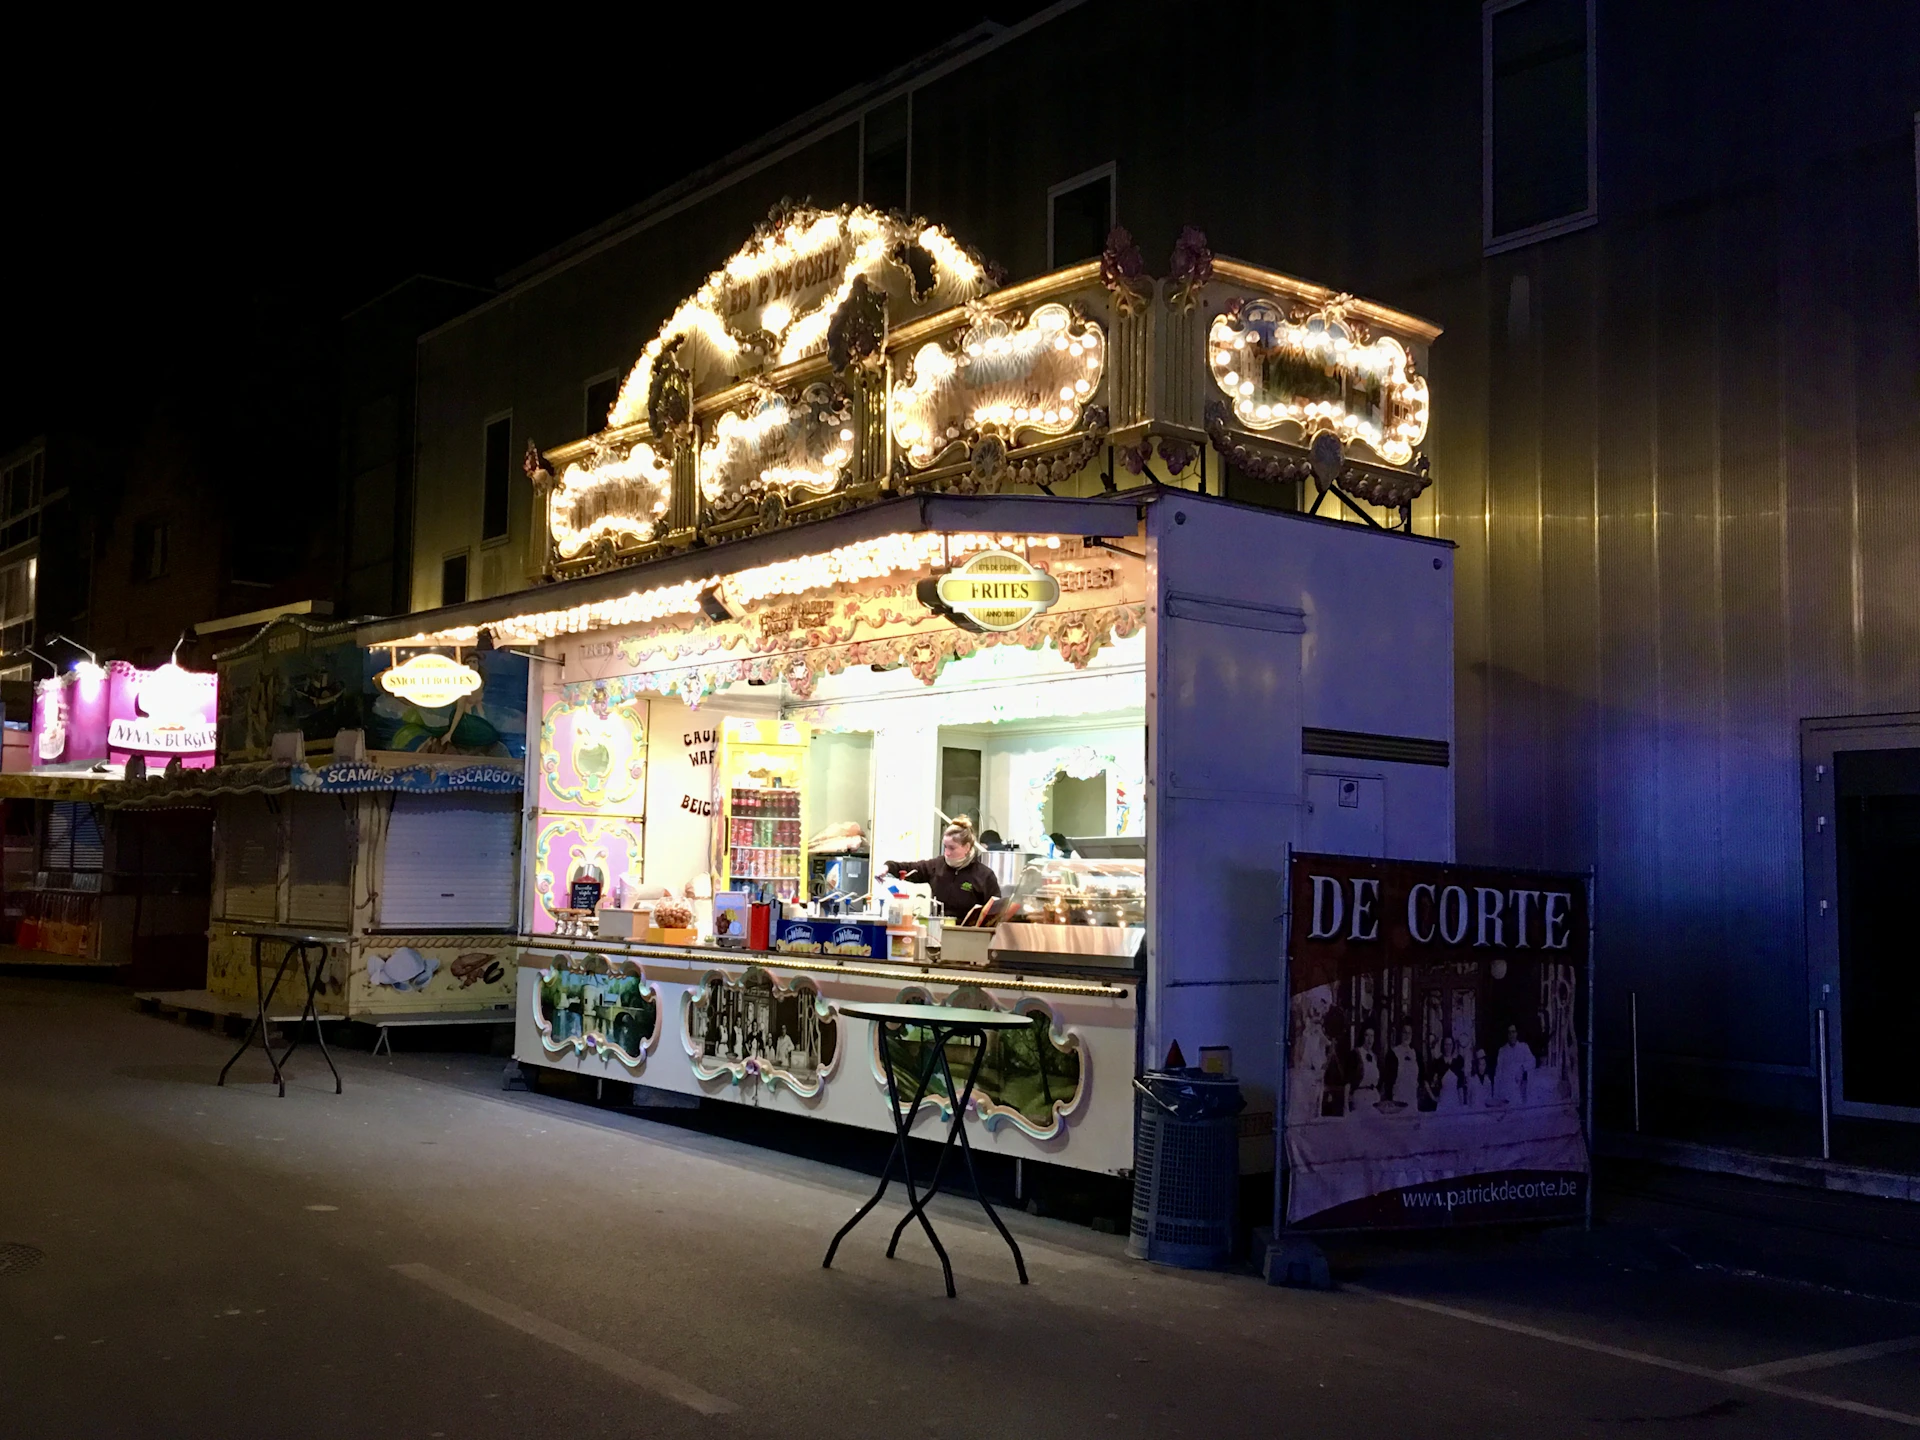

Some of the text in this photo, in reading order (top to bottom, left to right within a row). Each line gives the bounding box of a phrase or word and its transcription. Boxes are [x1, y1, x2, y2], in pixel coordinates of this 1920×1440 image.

[991, 563, 999, 572] DE
[999, 563, 1019, 572] CORTE
[971, 582, 1029, 599] FRITES
[985, 610, 1002, 618] ANNO
[327, 767, 395, 785] SCAMPIS
[1306, 874, 1573, 951] DE CORTE
[1401, 1179, 1577, 1211] www.patrickdecorte.be
